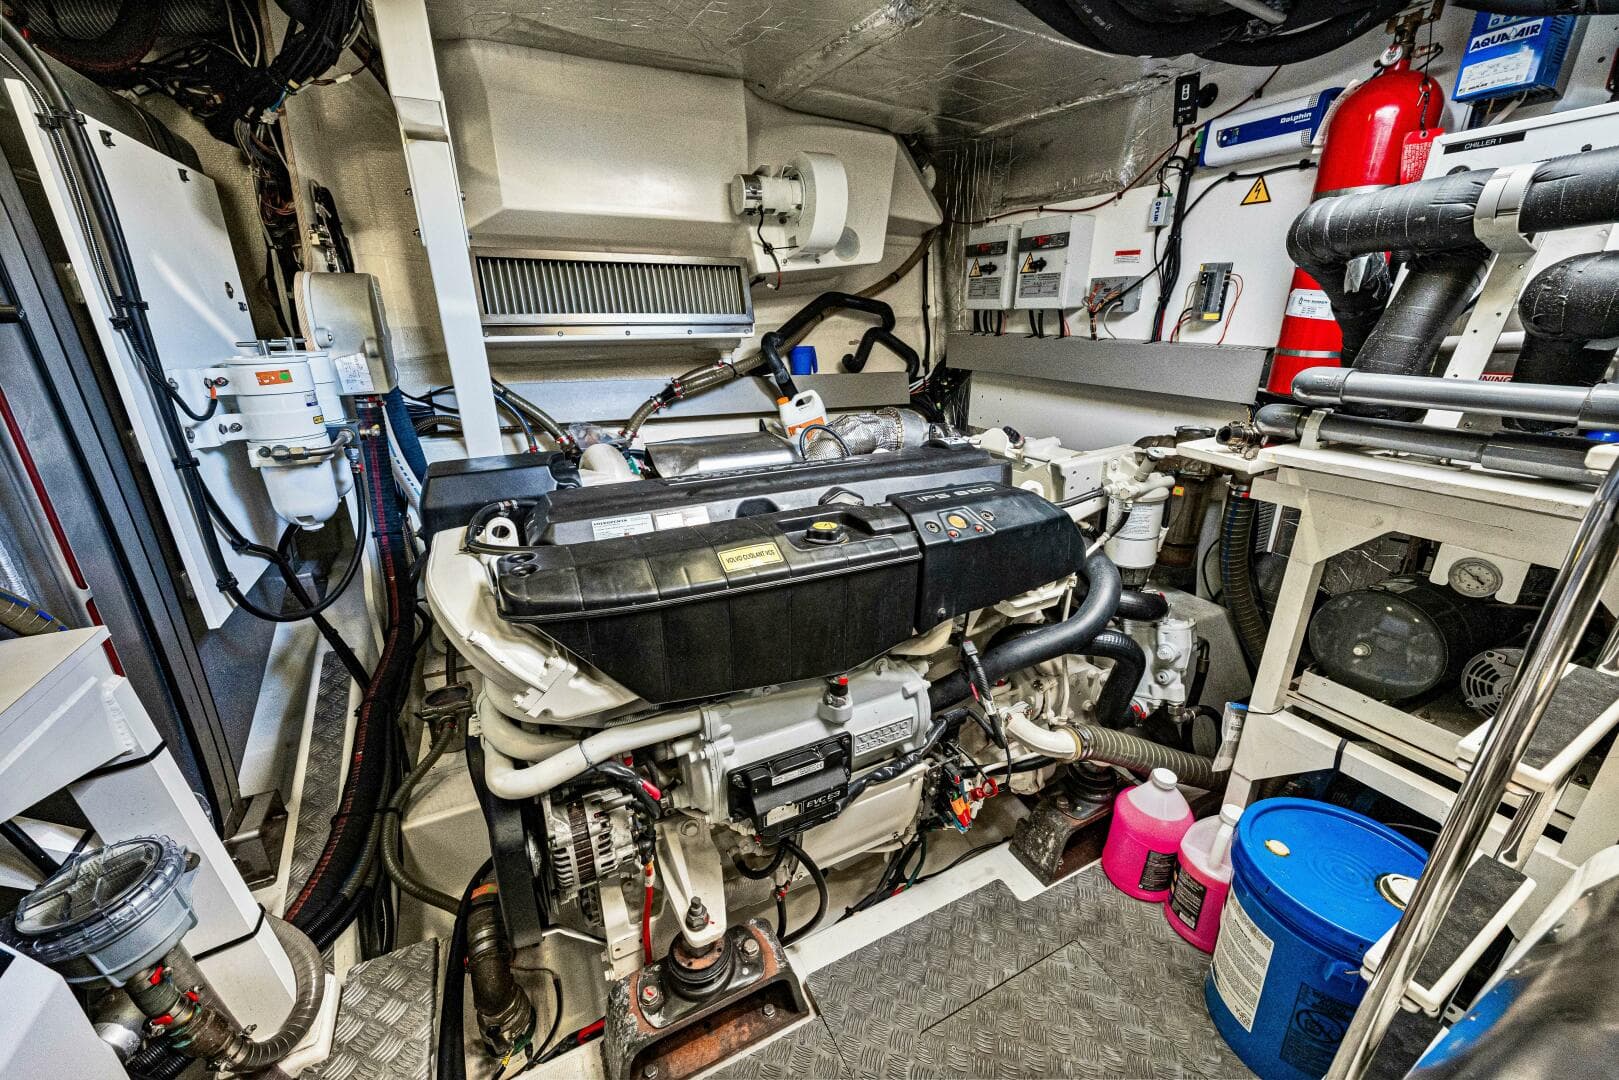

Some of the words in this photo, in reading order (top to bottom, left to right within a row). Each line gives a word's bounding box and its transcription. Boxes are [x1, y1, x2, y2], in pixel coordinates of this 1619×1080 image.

[1470, 33, 1512, 51] AQUA
[1514, 24, 1541, 38] AIR
[1280, 112, 1312, 124] Dolphin
[1464, 138, 1497, 150] CHILLER
[856, 721, 908, 743] VOLVO
